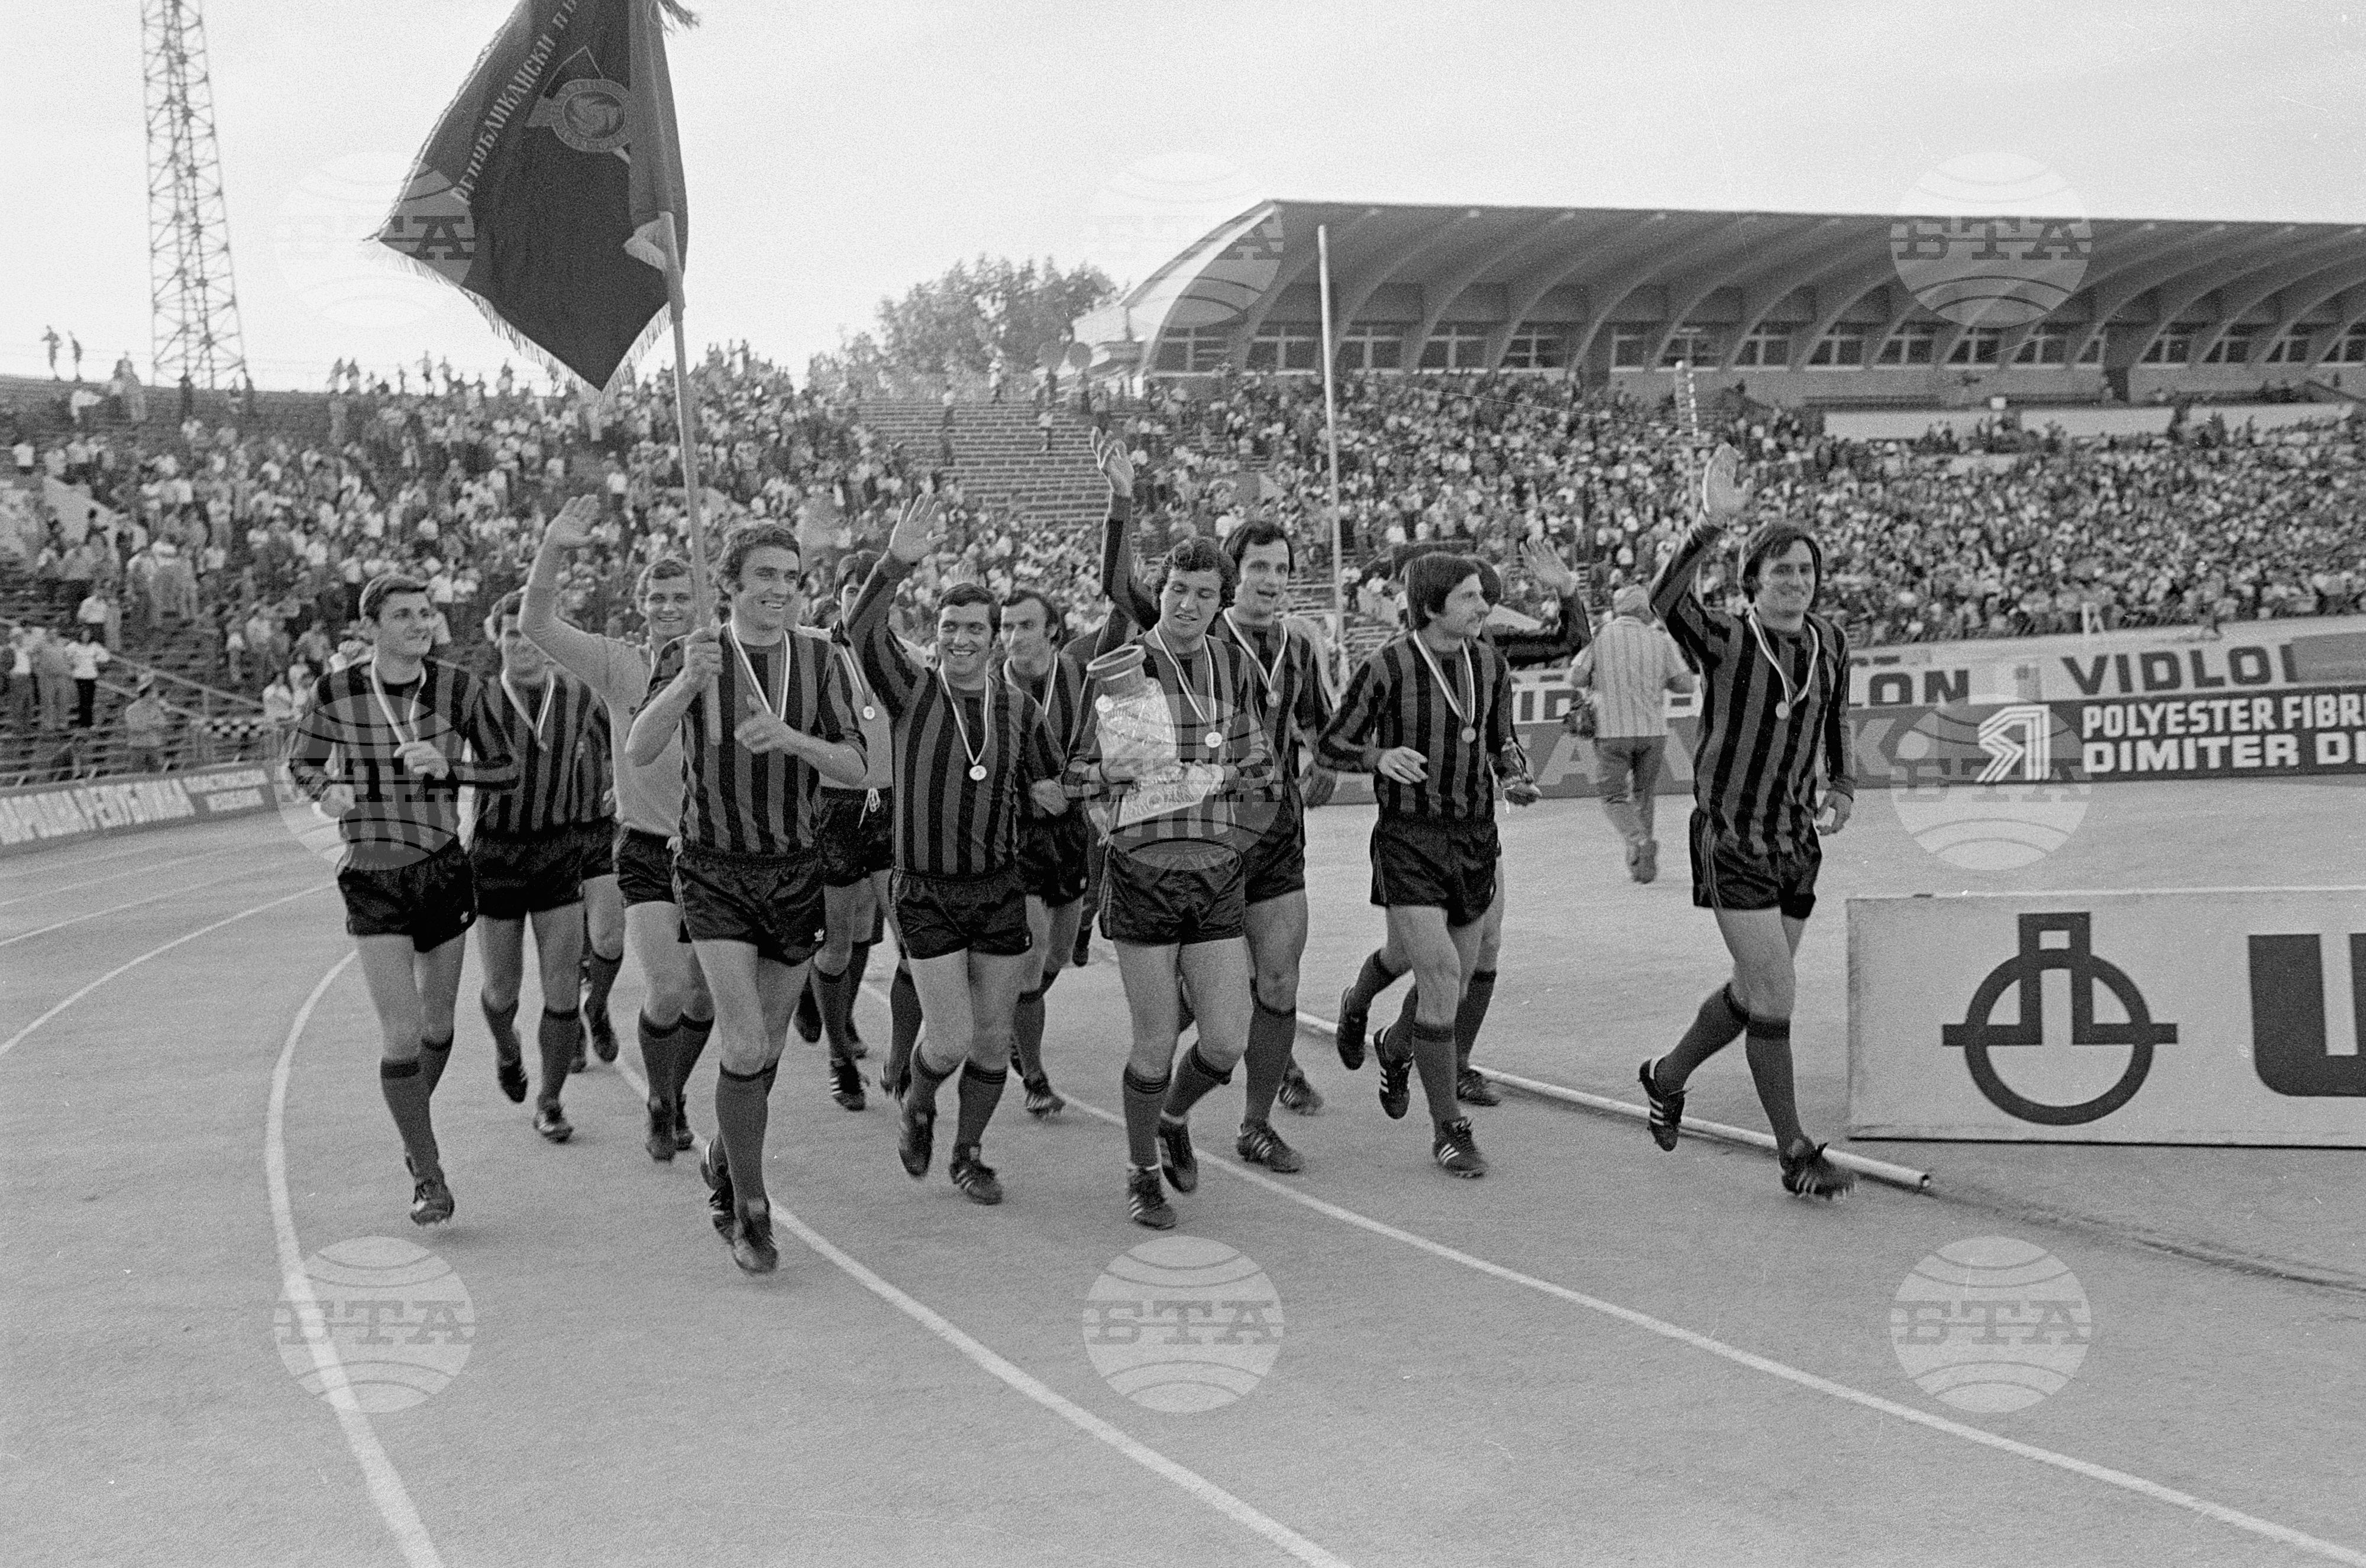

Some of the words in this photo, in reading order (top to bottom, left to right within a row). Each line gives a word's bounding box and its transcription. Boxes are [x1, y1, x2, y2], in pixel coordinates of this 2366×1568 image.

[2083, 697, 2277, 739] POLYESTER
[2282, 694, 2366, 729] FIBR
[2083, 734, 2300, 773] DIMITER
